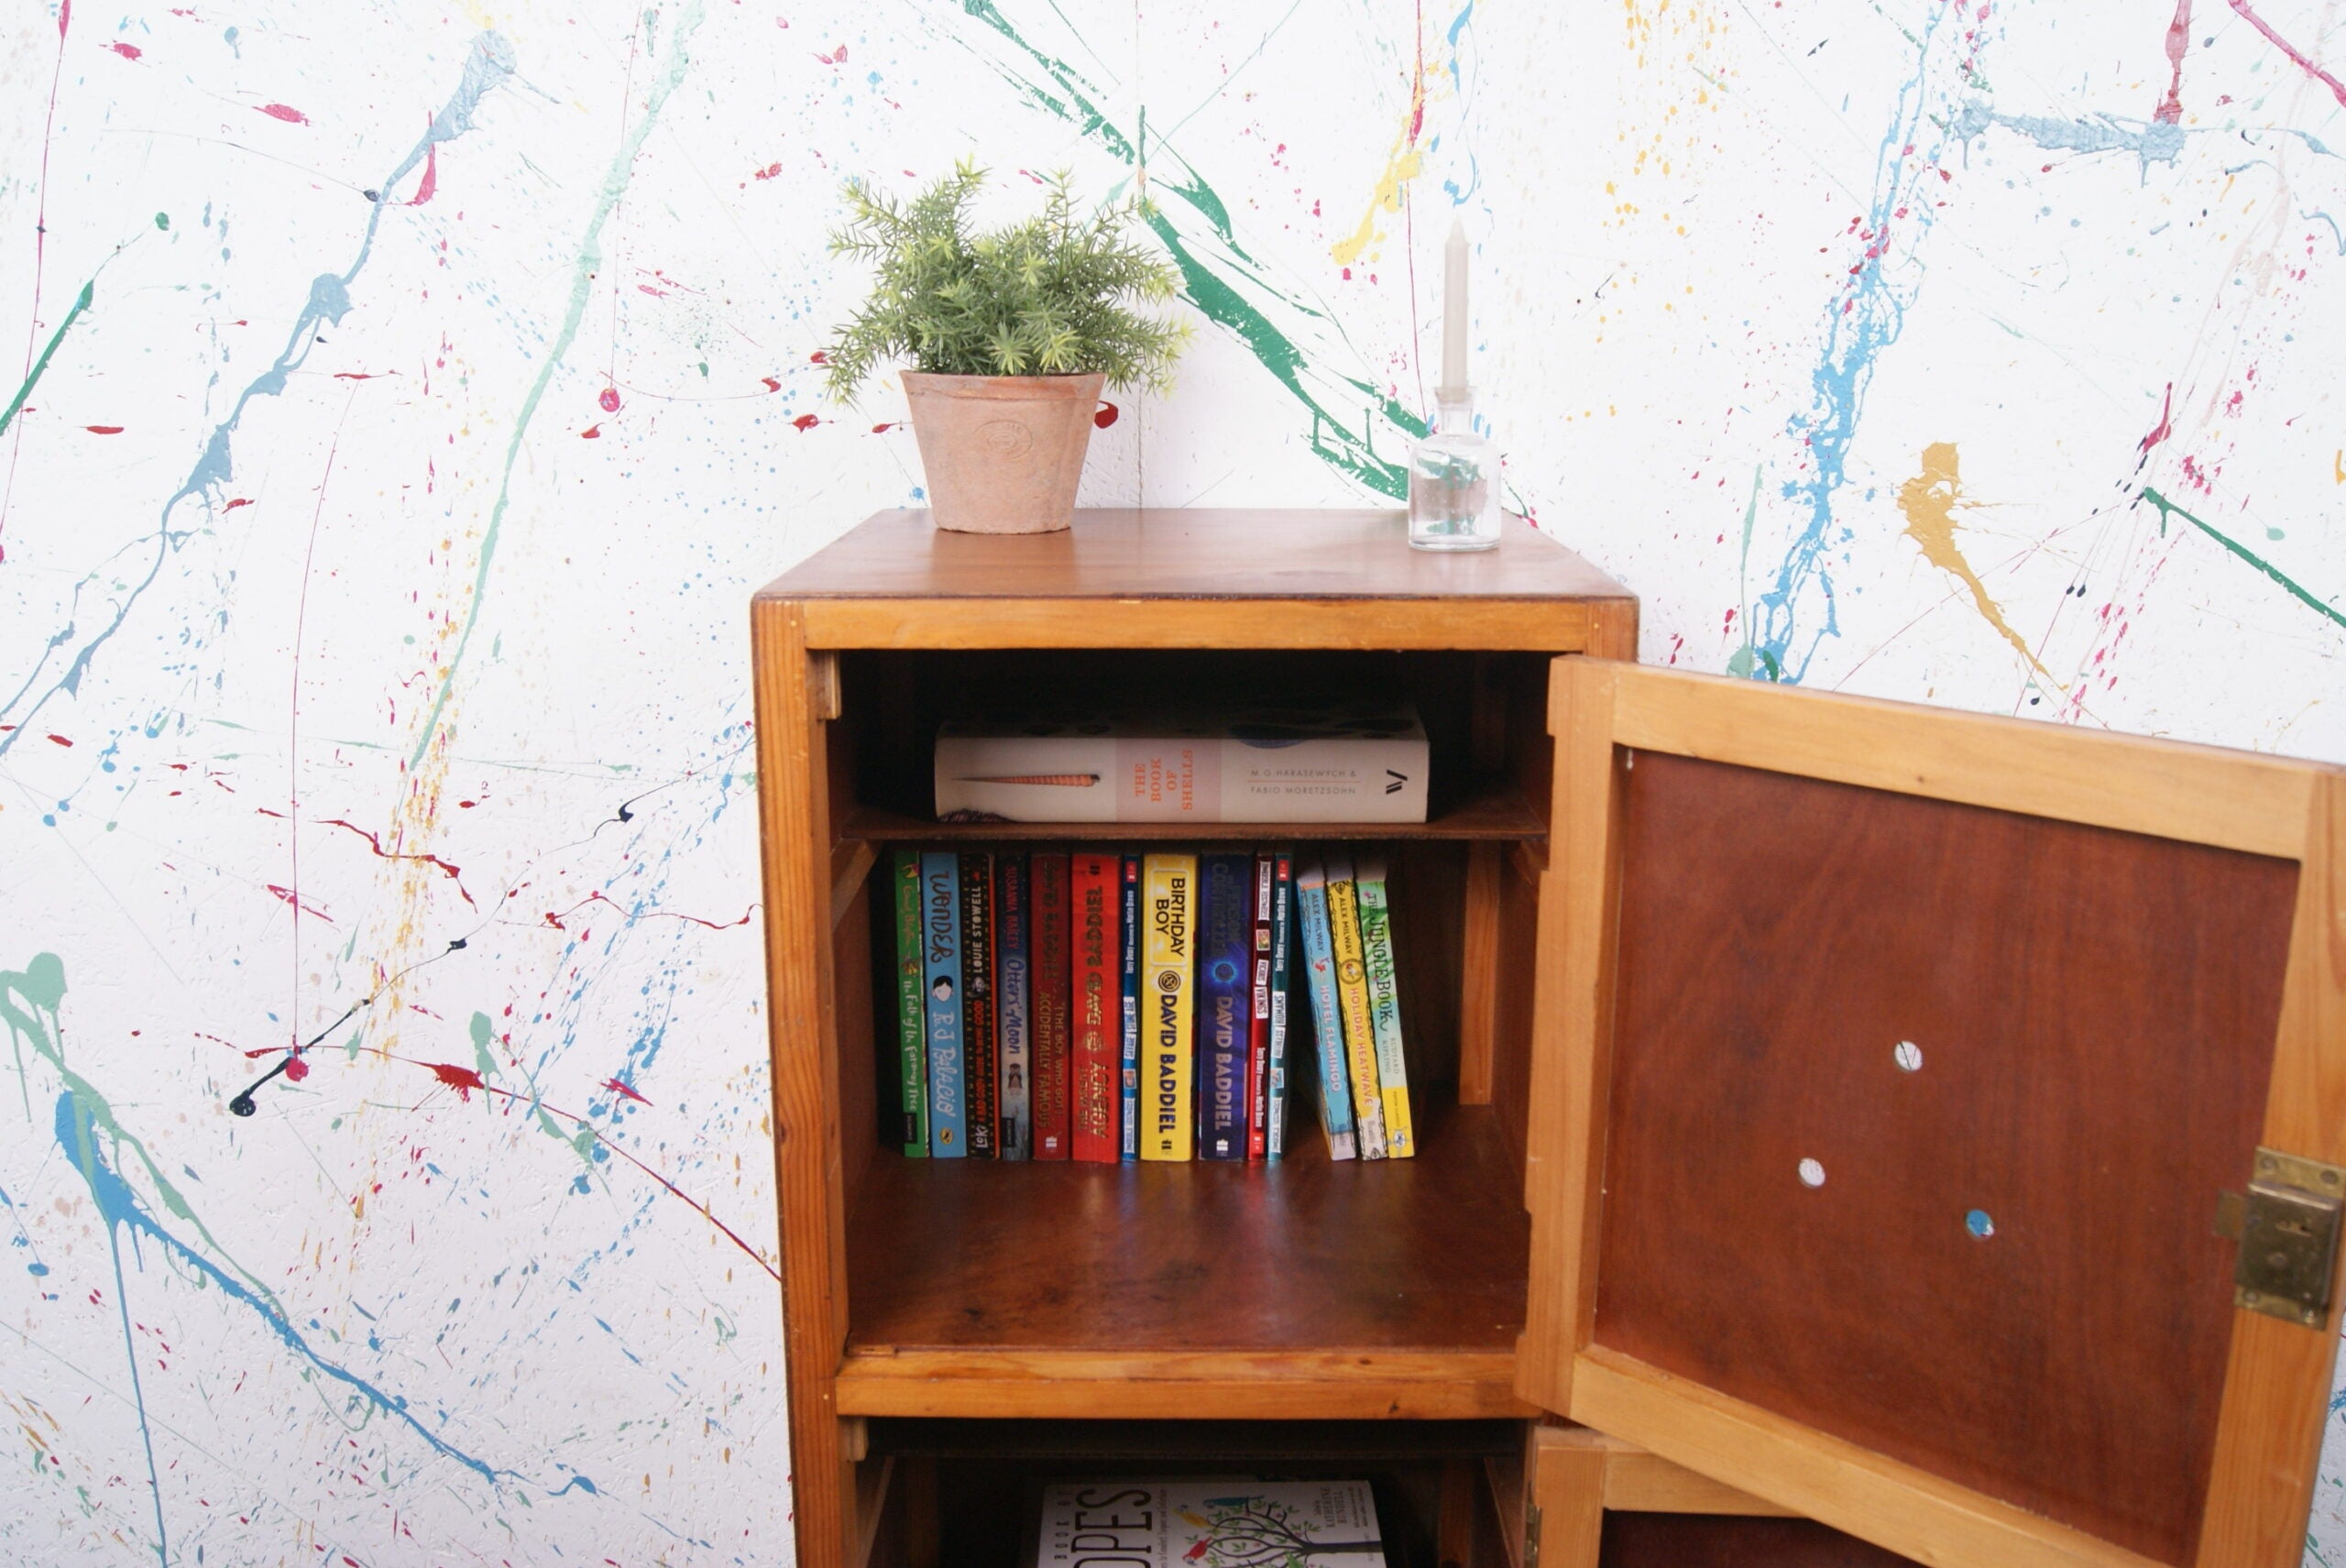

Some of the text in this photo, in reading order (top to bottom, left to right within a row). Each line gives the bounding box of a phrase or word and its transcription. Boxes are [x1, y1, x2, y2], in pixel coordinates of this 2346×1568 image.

[1135, 763, 1146, 796] THE
[1151, 758, 1162, 802] BOOK
[1166, 770, 1177, 791] OF
[1182, 750, 1193, 810] SHELLS
[1251, 785, 1356, 795] FABIO MORETZSOHN
[1277, 769, 1346, 778] HARASEWYCH
[1349, 769, 1357, 778] &
[1004, 865, 1020, 949] SUSANNA BAILEY
[1156, 898, 1169, 936] BOY
[1170, 877, 1186, 958] BIRTHDAY
[1311, 894, 1325, 952] ALEX MILWAY
[1339, 897, 1354, 956] ALEX MILWAY
[970, 886, 982, 974] LOUIE STOWELL
[1085, 885, 1102, 1025] DAVID BADDIEL
[1366, 894, 1394, 1032] THE JUNGLE BOOK
[905, 995, 919, 1016] Folk
[972, 1001, 984, 1026] GOOD
[1255, 988, 1268, 1014] VIKINGS
[1274, 994, 1285, 1025] ROMANS
[1350, 987, 1366, 1040] HOLIDAY
[903, 1017, 917, 1028] of
[1006, 1009, 1022, 1055] Moon
[1320, 984, 1343, 1093] HOTEL FLAMINGO
[1037, 992, 1051, 1128] ACCIDENTALLY FAMOUS
[1055, 1035, 1064, 1054] BOY
[1158, 994, 1178, 1135] DAVID BADDIEL
[1215, 996, 1233, 1131] DAVID BADDIEL
[1381, 1040, 1392, 1074] KIPLING
[1389, 1037, 1400, 1076] RUDYARD
[904, 1046, 919, 1086] Faraway
[1055, 1059, 1064, 1086] WHO
[1357, 1042, 1374, 1107] HEATWAVE
[909, 1089, 919, 1112] Tree
[1089, 1059, 1109, 1139] AGENCY
[1054, 1521, 1069, 1561] BOOK
